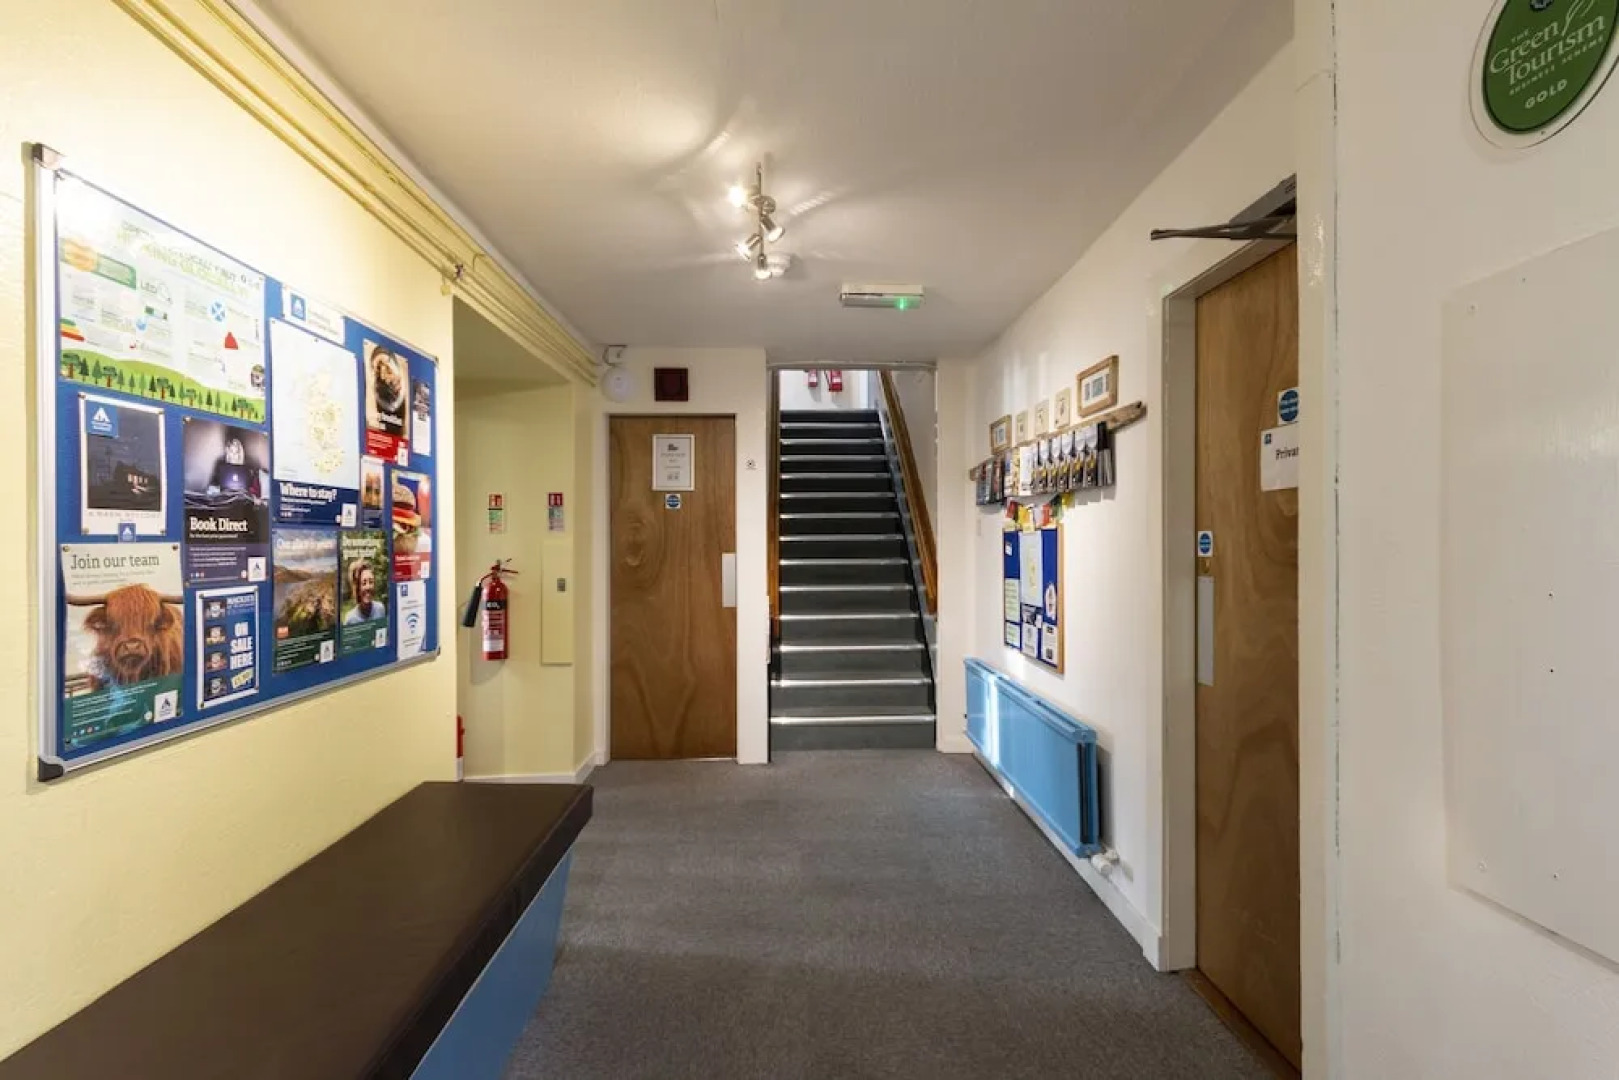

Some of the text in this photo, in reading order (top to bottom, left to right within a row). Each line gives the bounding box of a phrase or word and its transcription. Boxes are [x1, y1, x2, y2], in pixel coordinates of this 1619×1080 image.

[1489, 21, 1559, 74] Green
[1503, 15, 1604, 86] Tourism
[1524, 78, 1568, 110] GOLD
[279, 482, 308, 498] Where
[308, 486, 318, 498] to
[318, 488, 338, 503] stay?
[190, 515, 249, 532] Book Direct
[70, 553, 160, 571] Join our team
[229, 635, 254, 654] SALE
[229, 651, 254, 671] HERE
